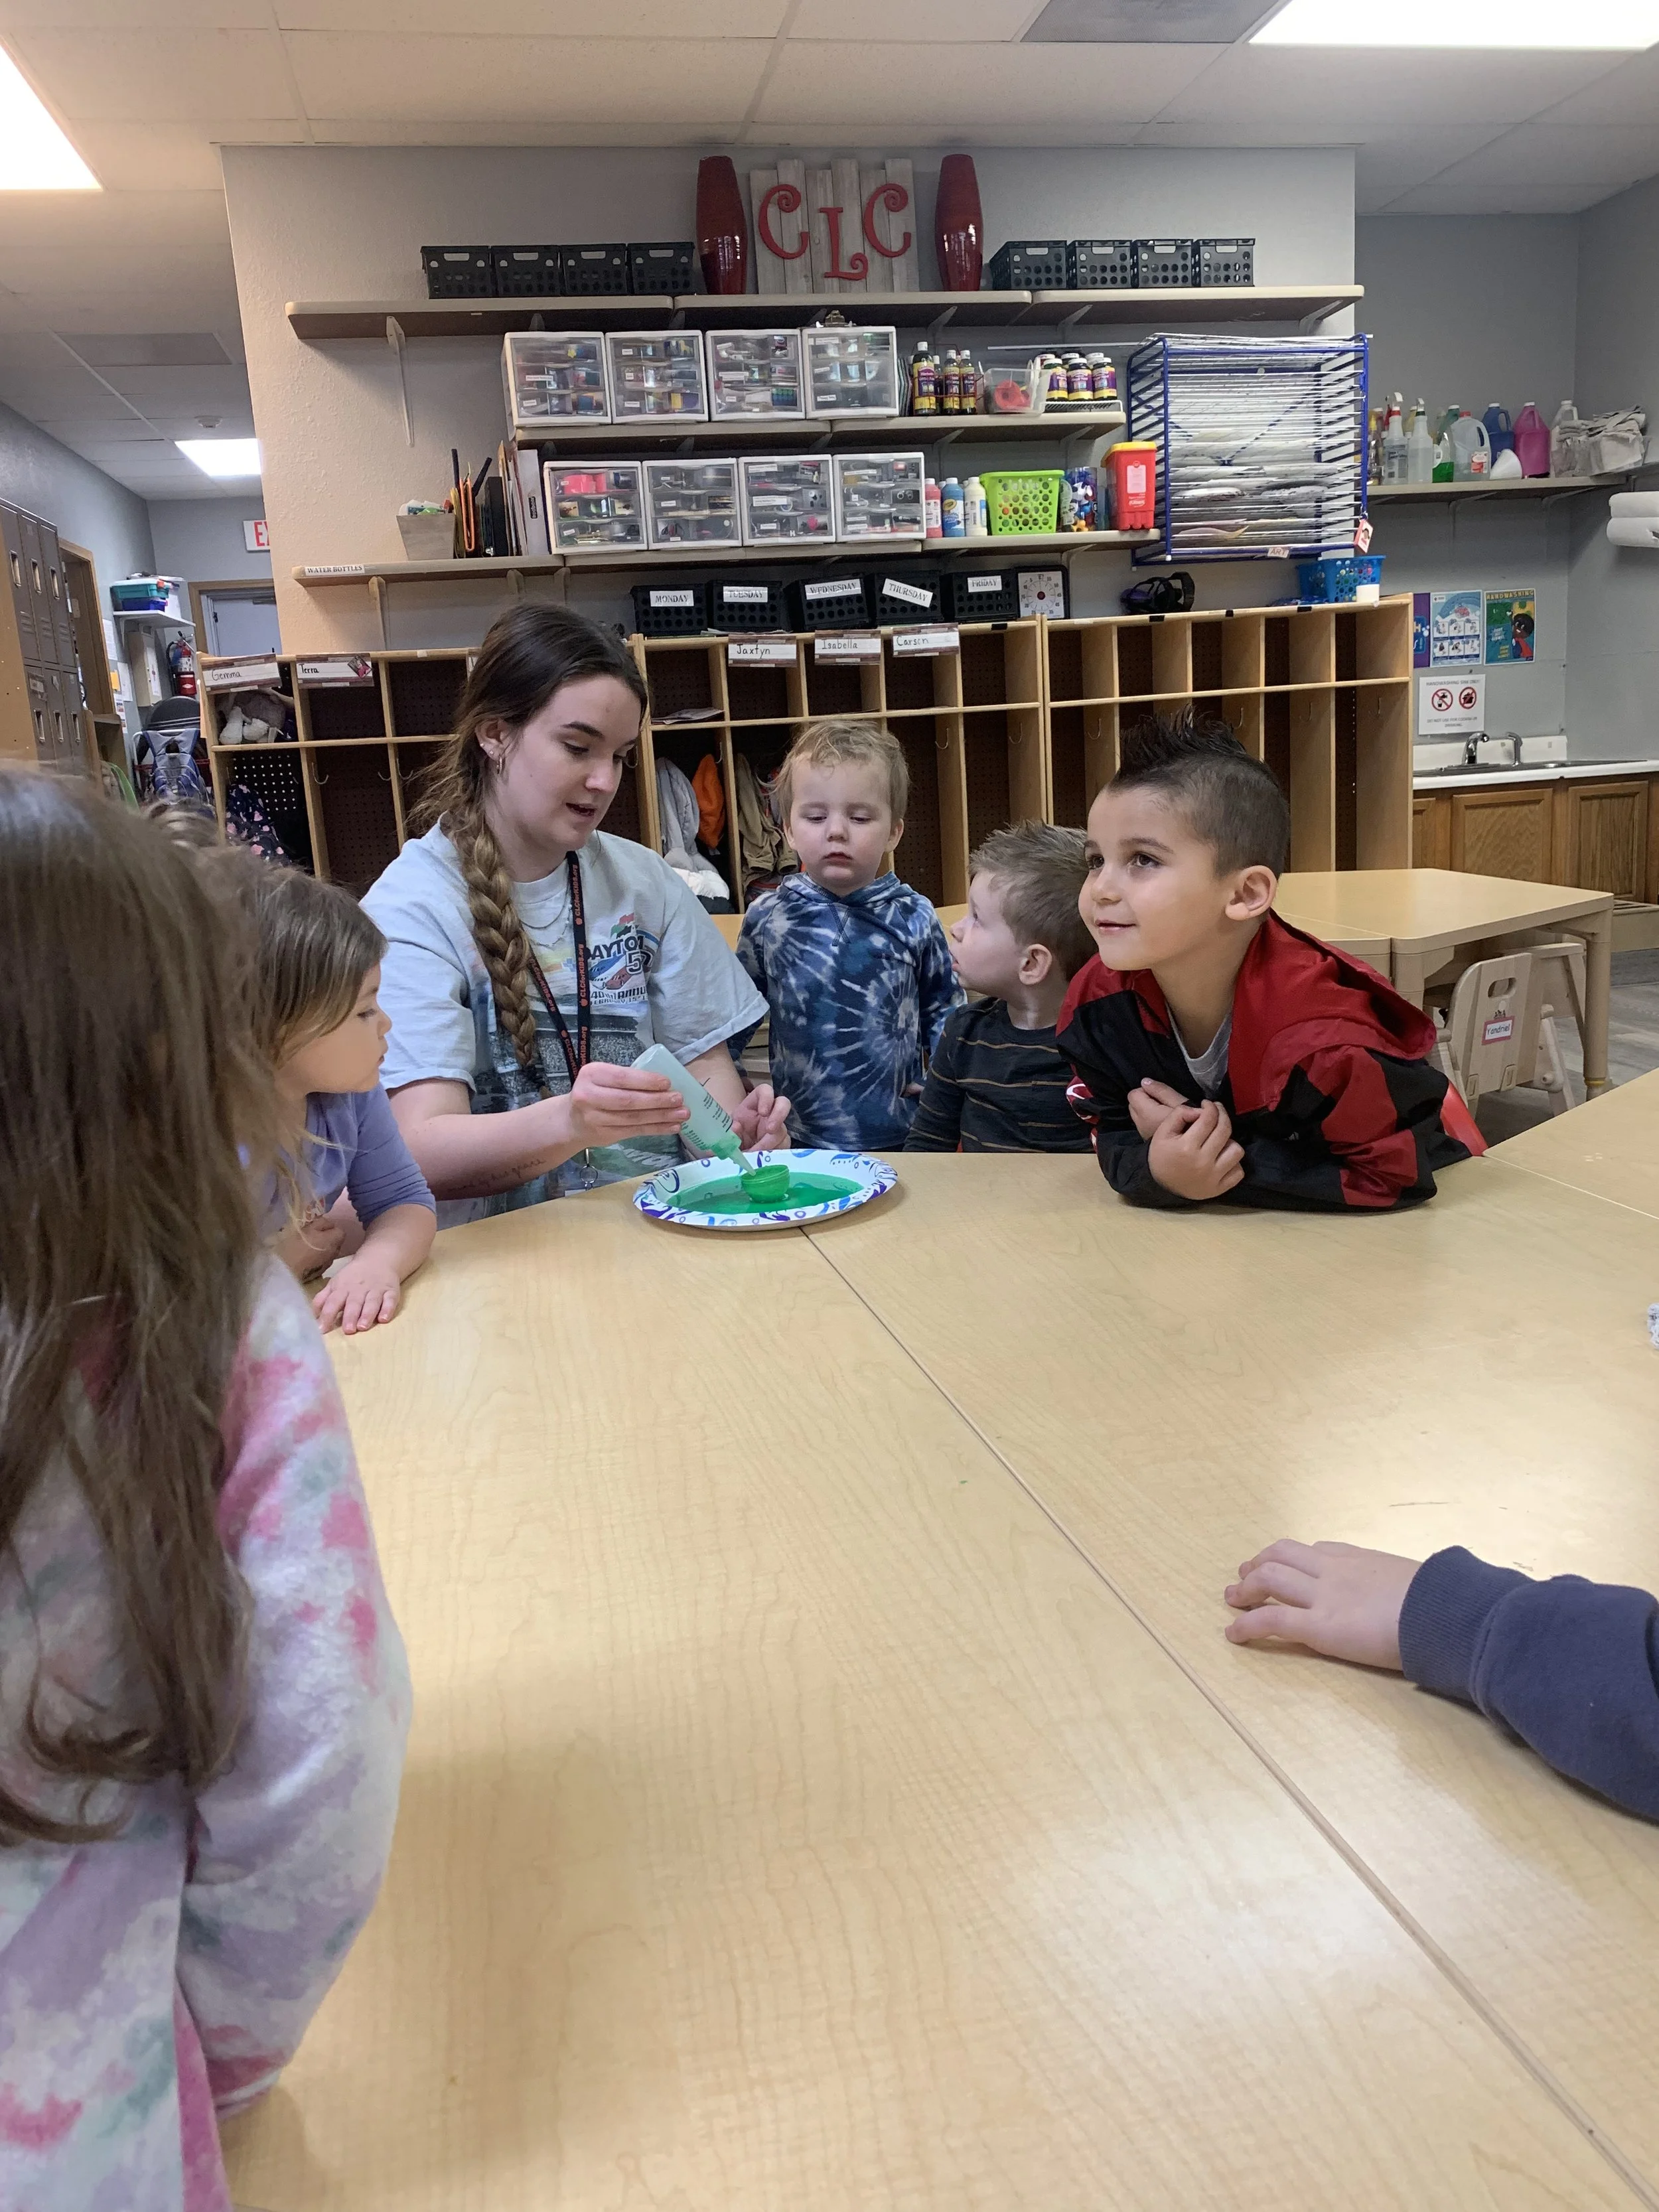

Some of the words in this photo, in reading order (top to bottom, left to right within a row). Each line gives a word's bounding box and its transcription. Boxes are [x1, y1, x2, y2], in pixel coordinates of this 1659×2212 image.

[758, 183, 911, 281] CLC
[810, 581, 857, 595] WEDNESDAY
[972, 579, 997, 587] FRIDAY
[654, 594, 689, 603] MONDAY
[729, 589, 763, 599] TUESDAY
[888, 583, 928, 602] THURSDAY
[1486, 589, 1534, 600] HANDWASHING
[822, 638, 858, 650] Isabella
[737, 643, 770, 659] Jaxtyn
[299, 664, 319, 674] Terra
[212, 669, 242, 682] Gemma
[572, 865, 581, 917] CLCforKIDS.org
